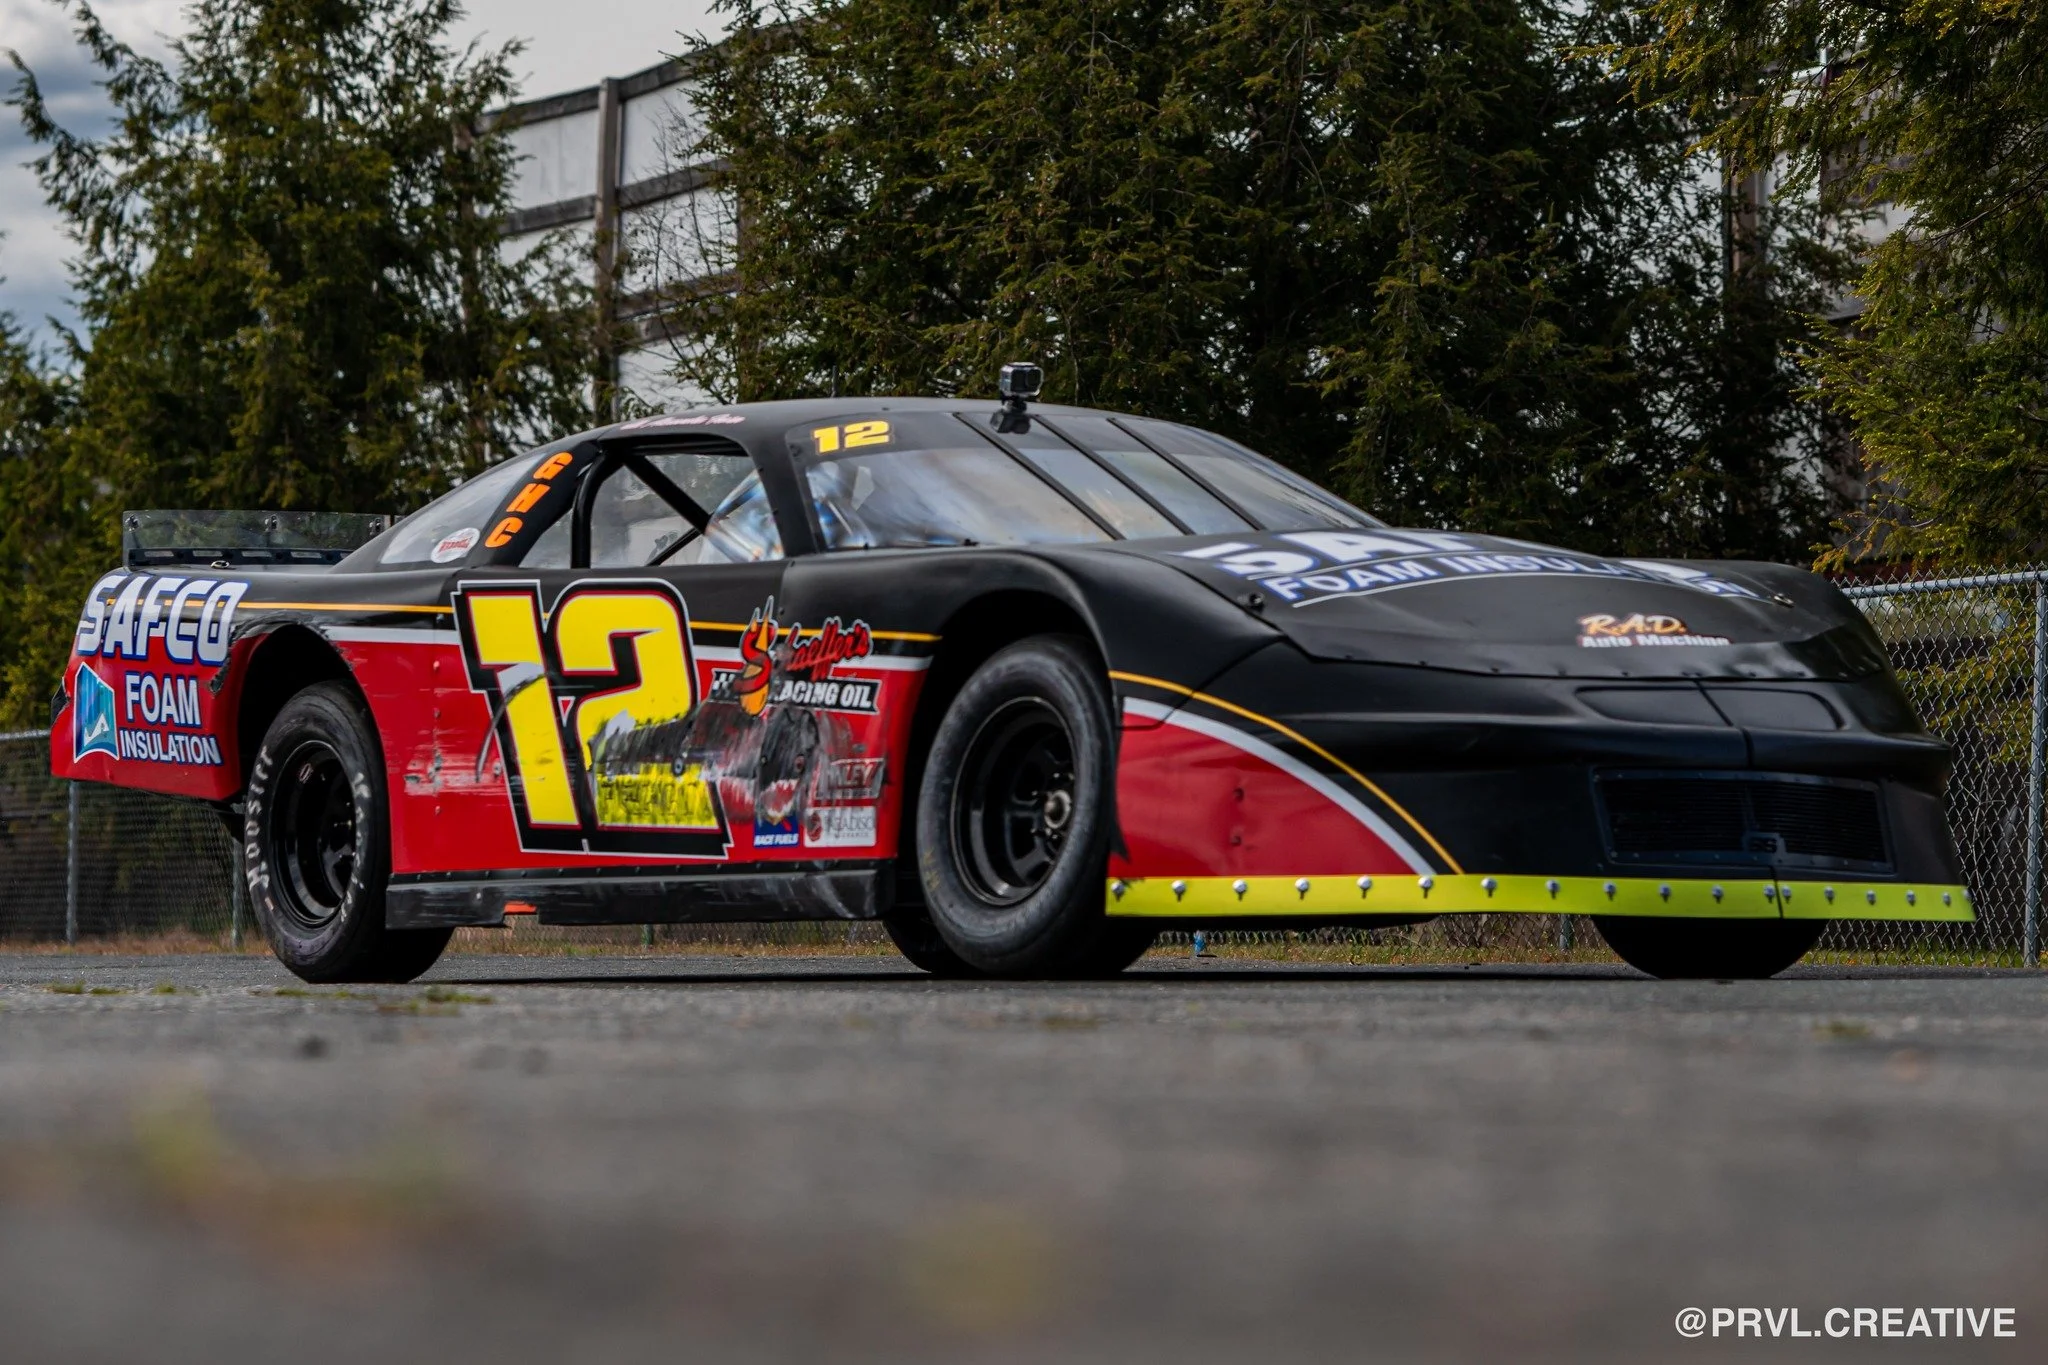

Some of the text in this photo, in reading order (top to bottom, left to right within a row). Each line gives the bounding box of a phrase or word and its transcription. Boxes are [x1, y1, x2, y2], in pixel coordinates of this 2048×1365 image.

[813, 420, 890, 453] 12
[1262, 555, 1762, 601] FOAM INSULA
[77, 574, 249, 664] SAFCO
[1578, 612, 1688, 636] R.A.D.
[740, 602, 874, 702] Shaeffer's
[1580, 635, 1632, 648] Auto
[125, 672, 202, 727] FOAM
[458, 583, 728, 845] 12
[769, 679, 873, 708] ACING OIL
[119, 728, 223, 765] INSULATION
